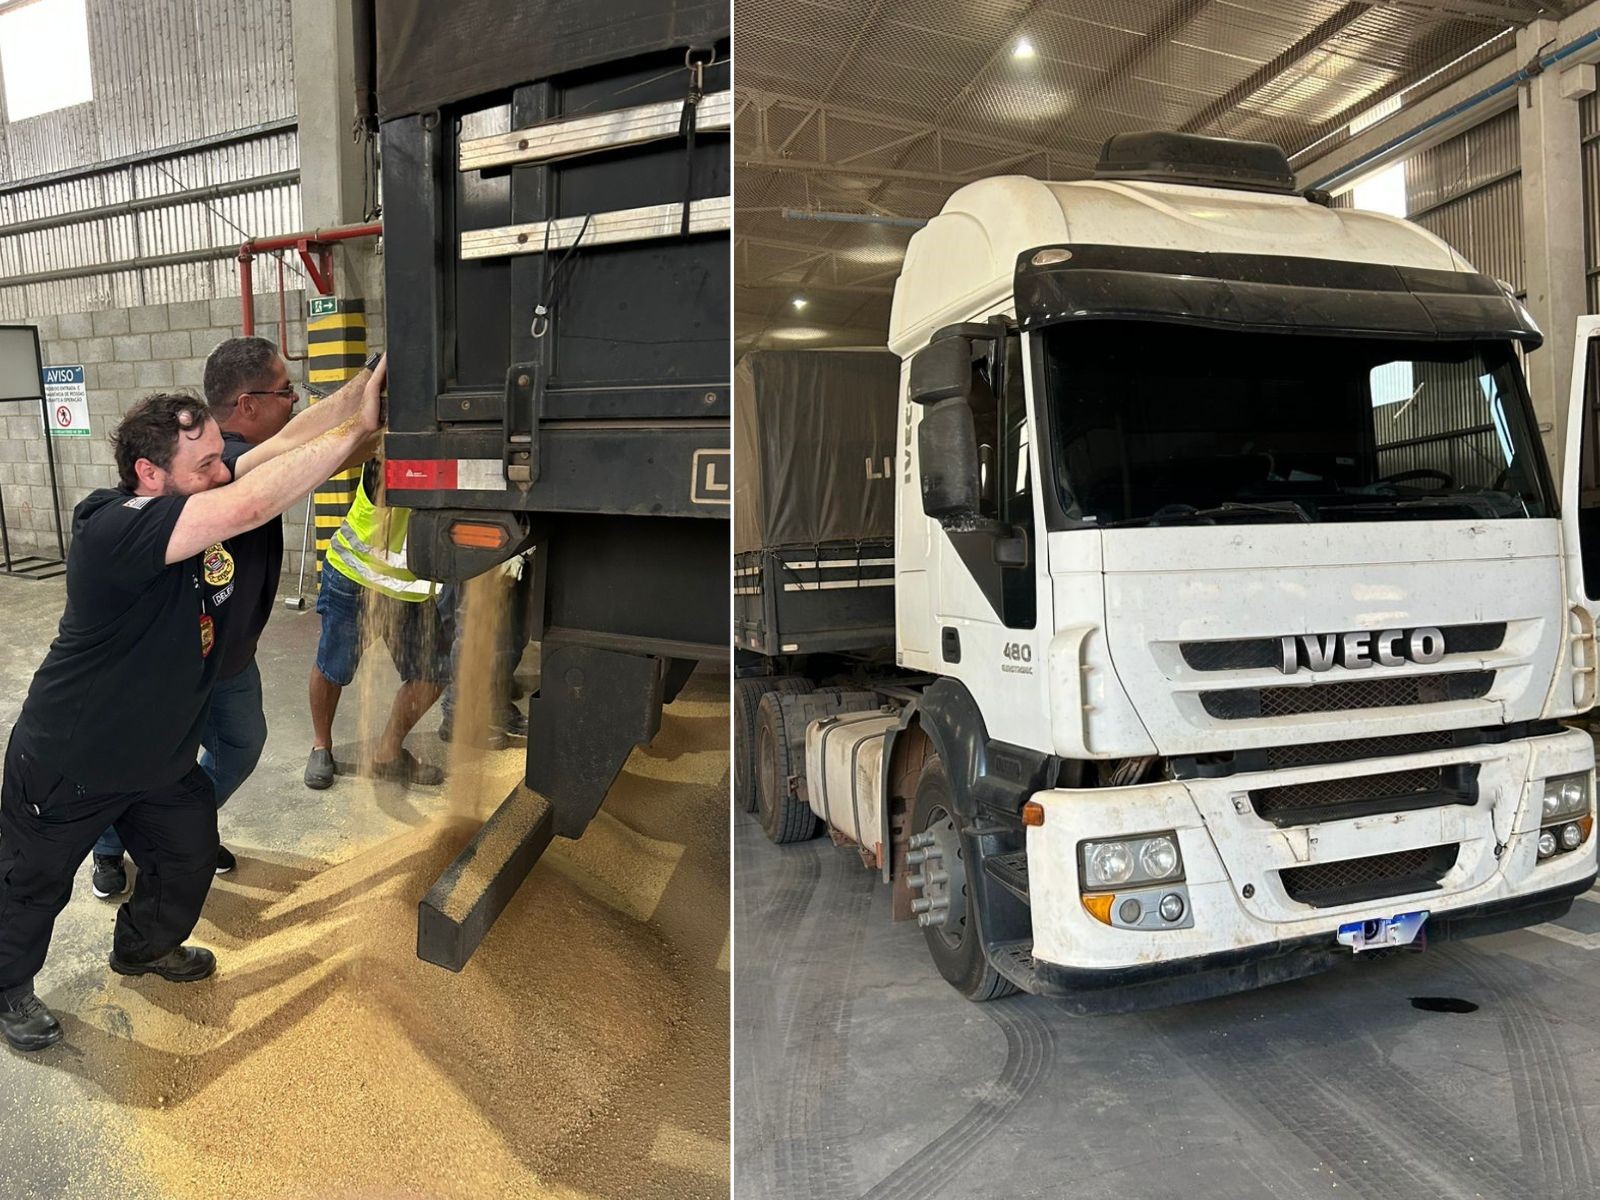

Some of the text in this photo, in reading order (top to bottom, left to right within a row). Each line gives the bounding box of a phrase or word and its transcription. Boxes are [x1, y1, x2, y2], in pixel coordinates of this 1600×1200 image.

[47, 369, 74, 382] AVISO
[705, 463, 729, 490] L
[1003, 642, 1032, 662] 480
[1281, 627, 1446, 675] IVECO
